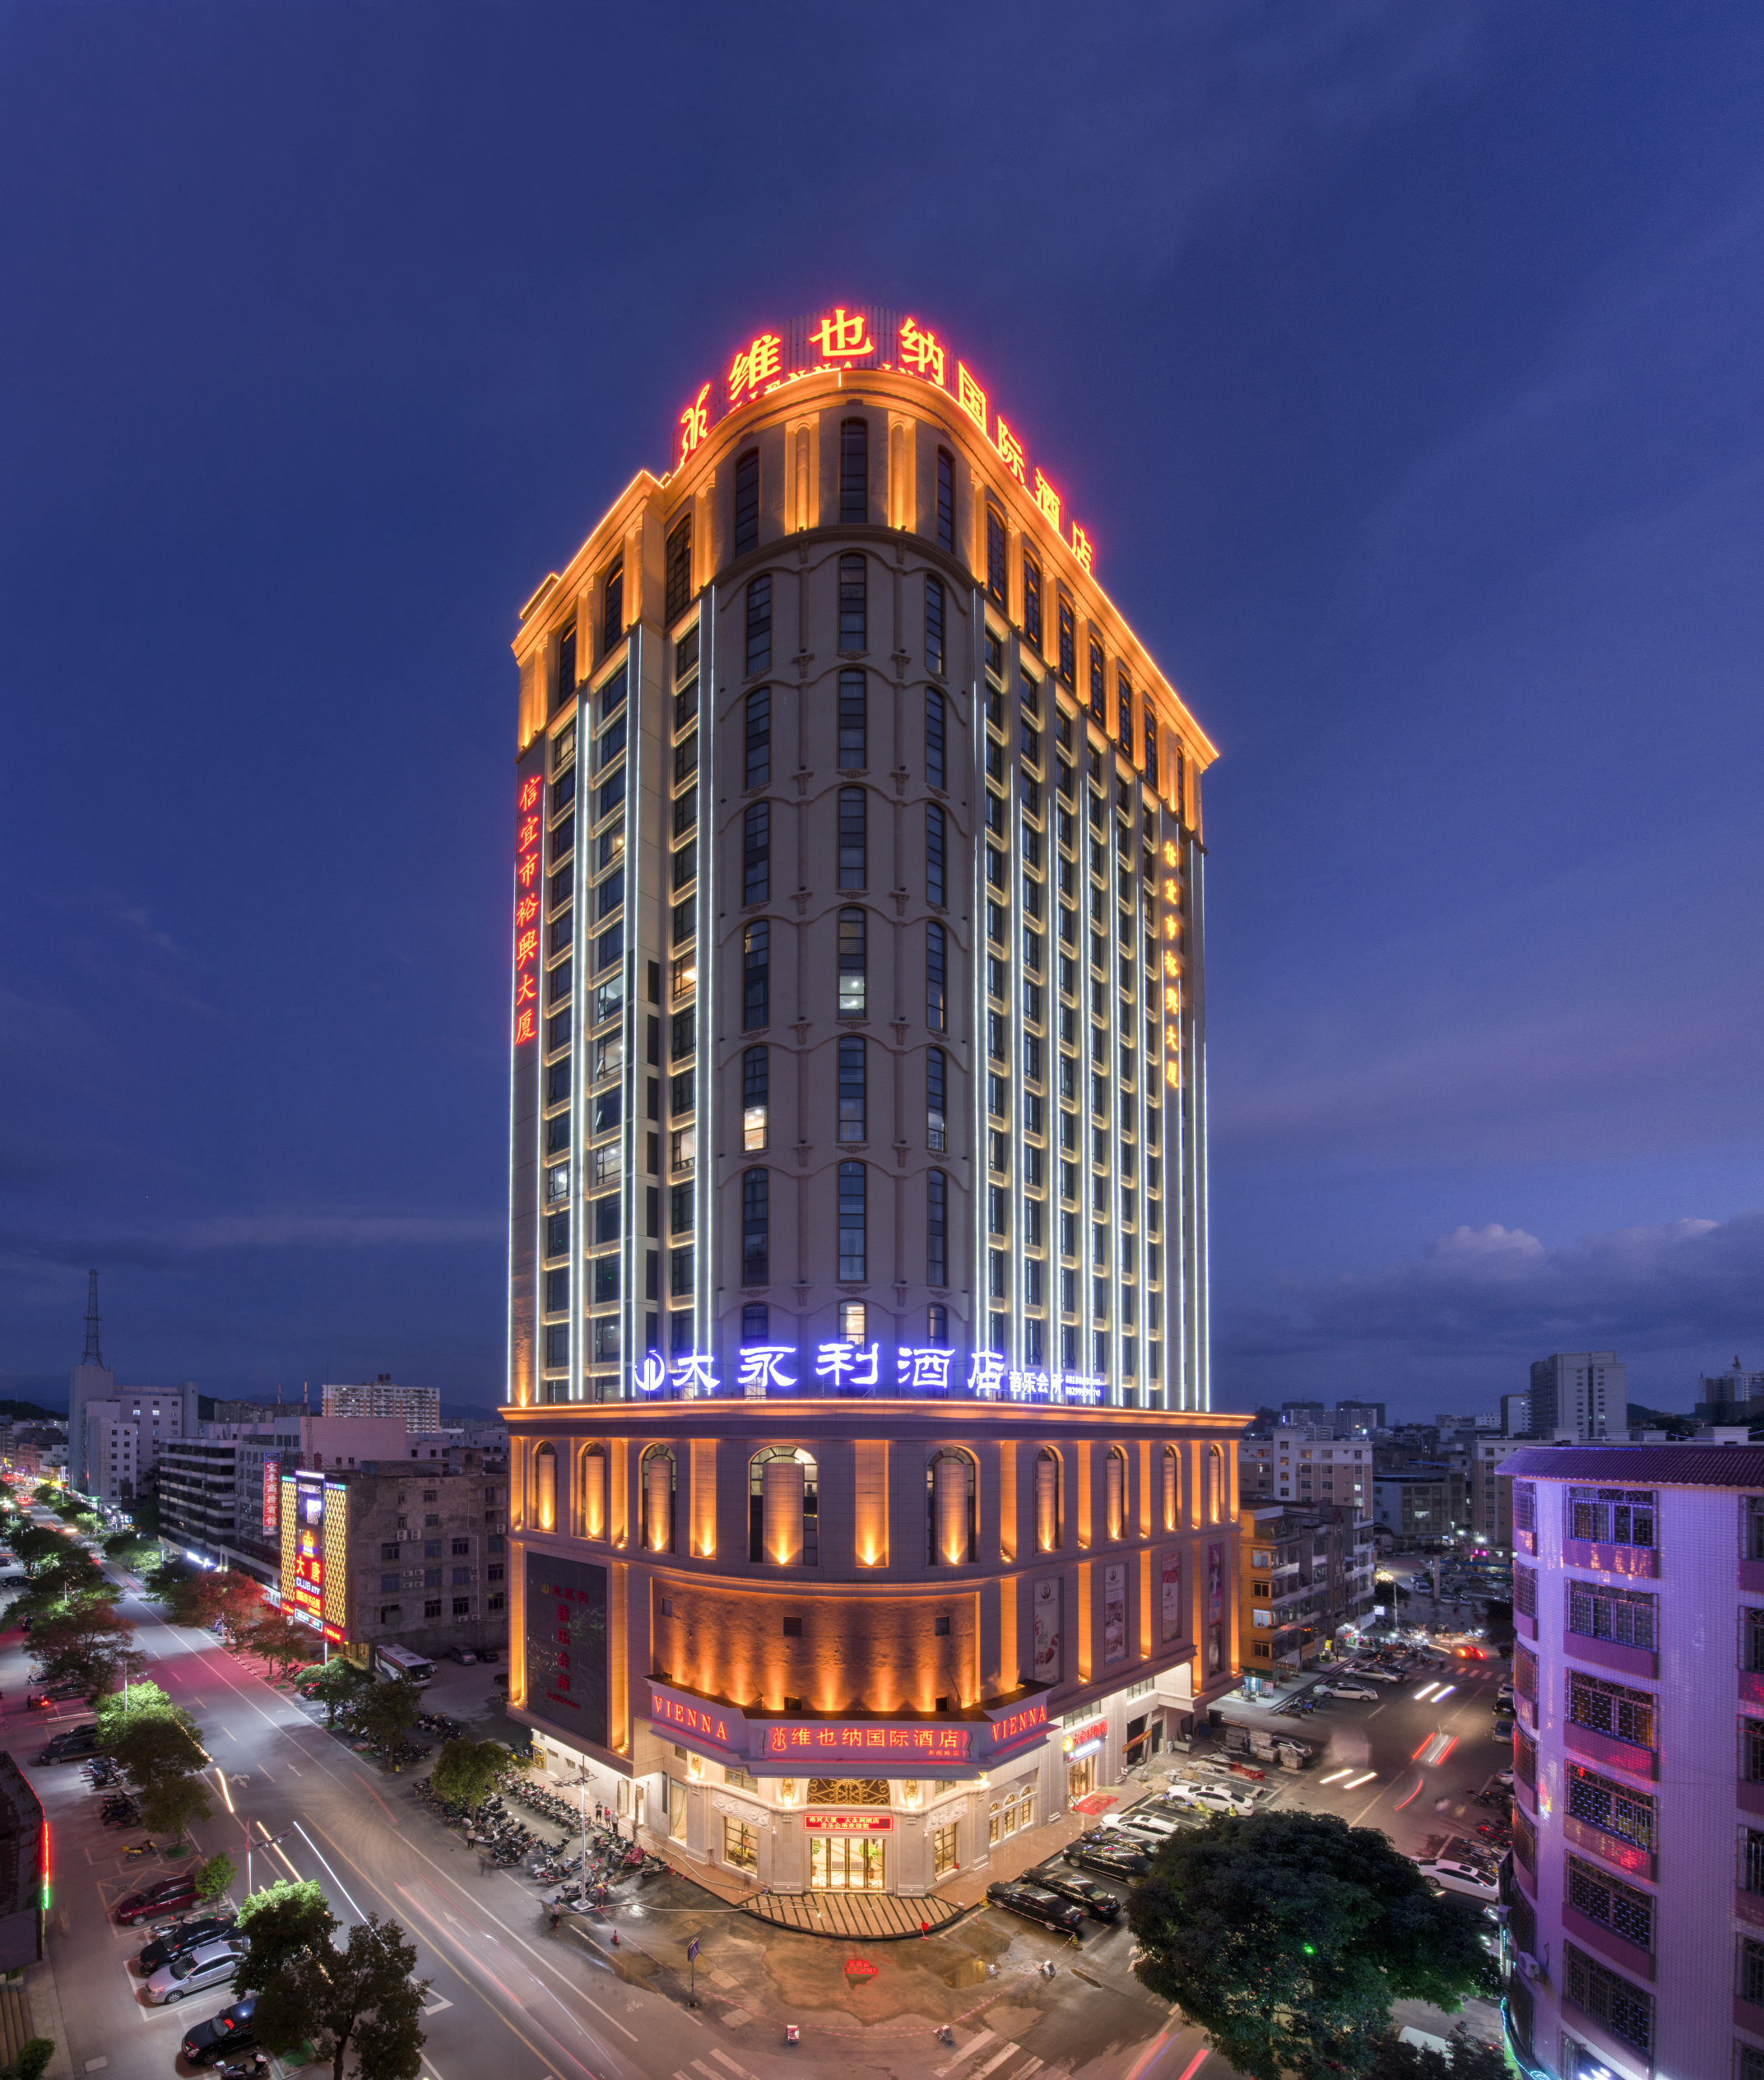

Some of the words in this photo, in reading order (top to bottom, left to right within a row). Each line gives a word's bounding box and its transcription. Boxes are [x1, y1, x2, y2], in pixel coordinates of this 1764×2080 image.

[728, 308, 1093, 574] 维也纳国际酒店
[515, 775, 542, 1045] 信宜市裕興大厦
[672, 1342, 1007, 1391] 大永利酒店
[1009, 1371, 1064, 1394] 音乐会所
[296, 1556, 321, 1582] 大唐
[296, 1577, 311, 1590] CLUB
[551, 1585, 587, 1604] 大永利
[556, 1604, 570, 1692] 音乐会所
[653, 1695, 728, 1741] VIENNA
[991, 1705, 1047, 1743] VIENNA
[791, 1728, 959, 1748] 维也纳国际酒店
